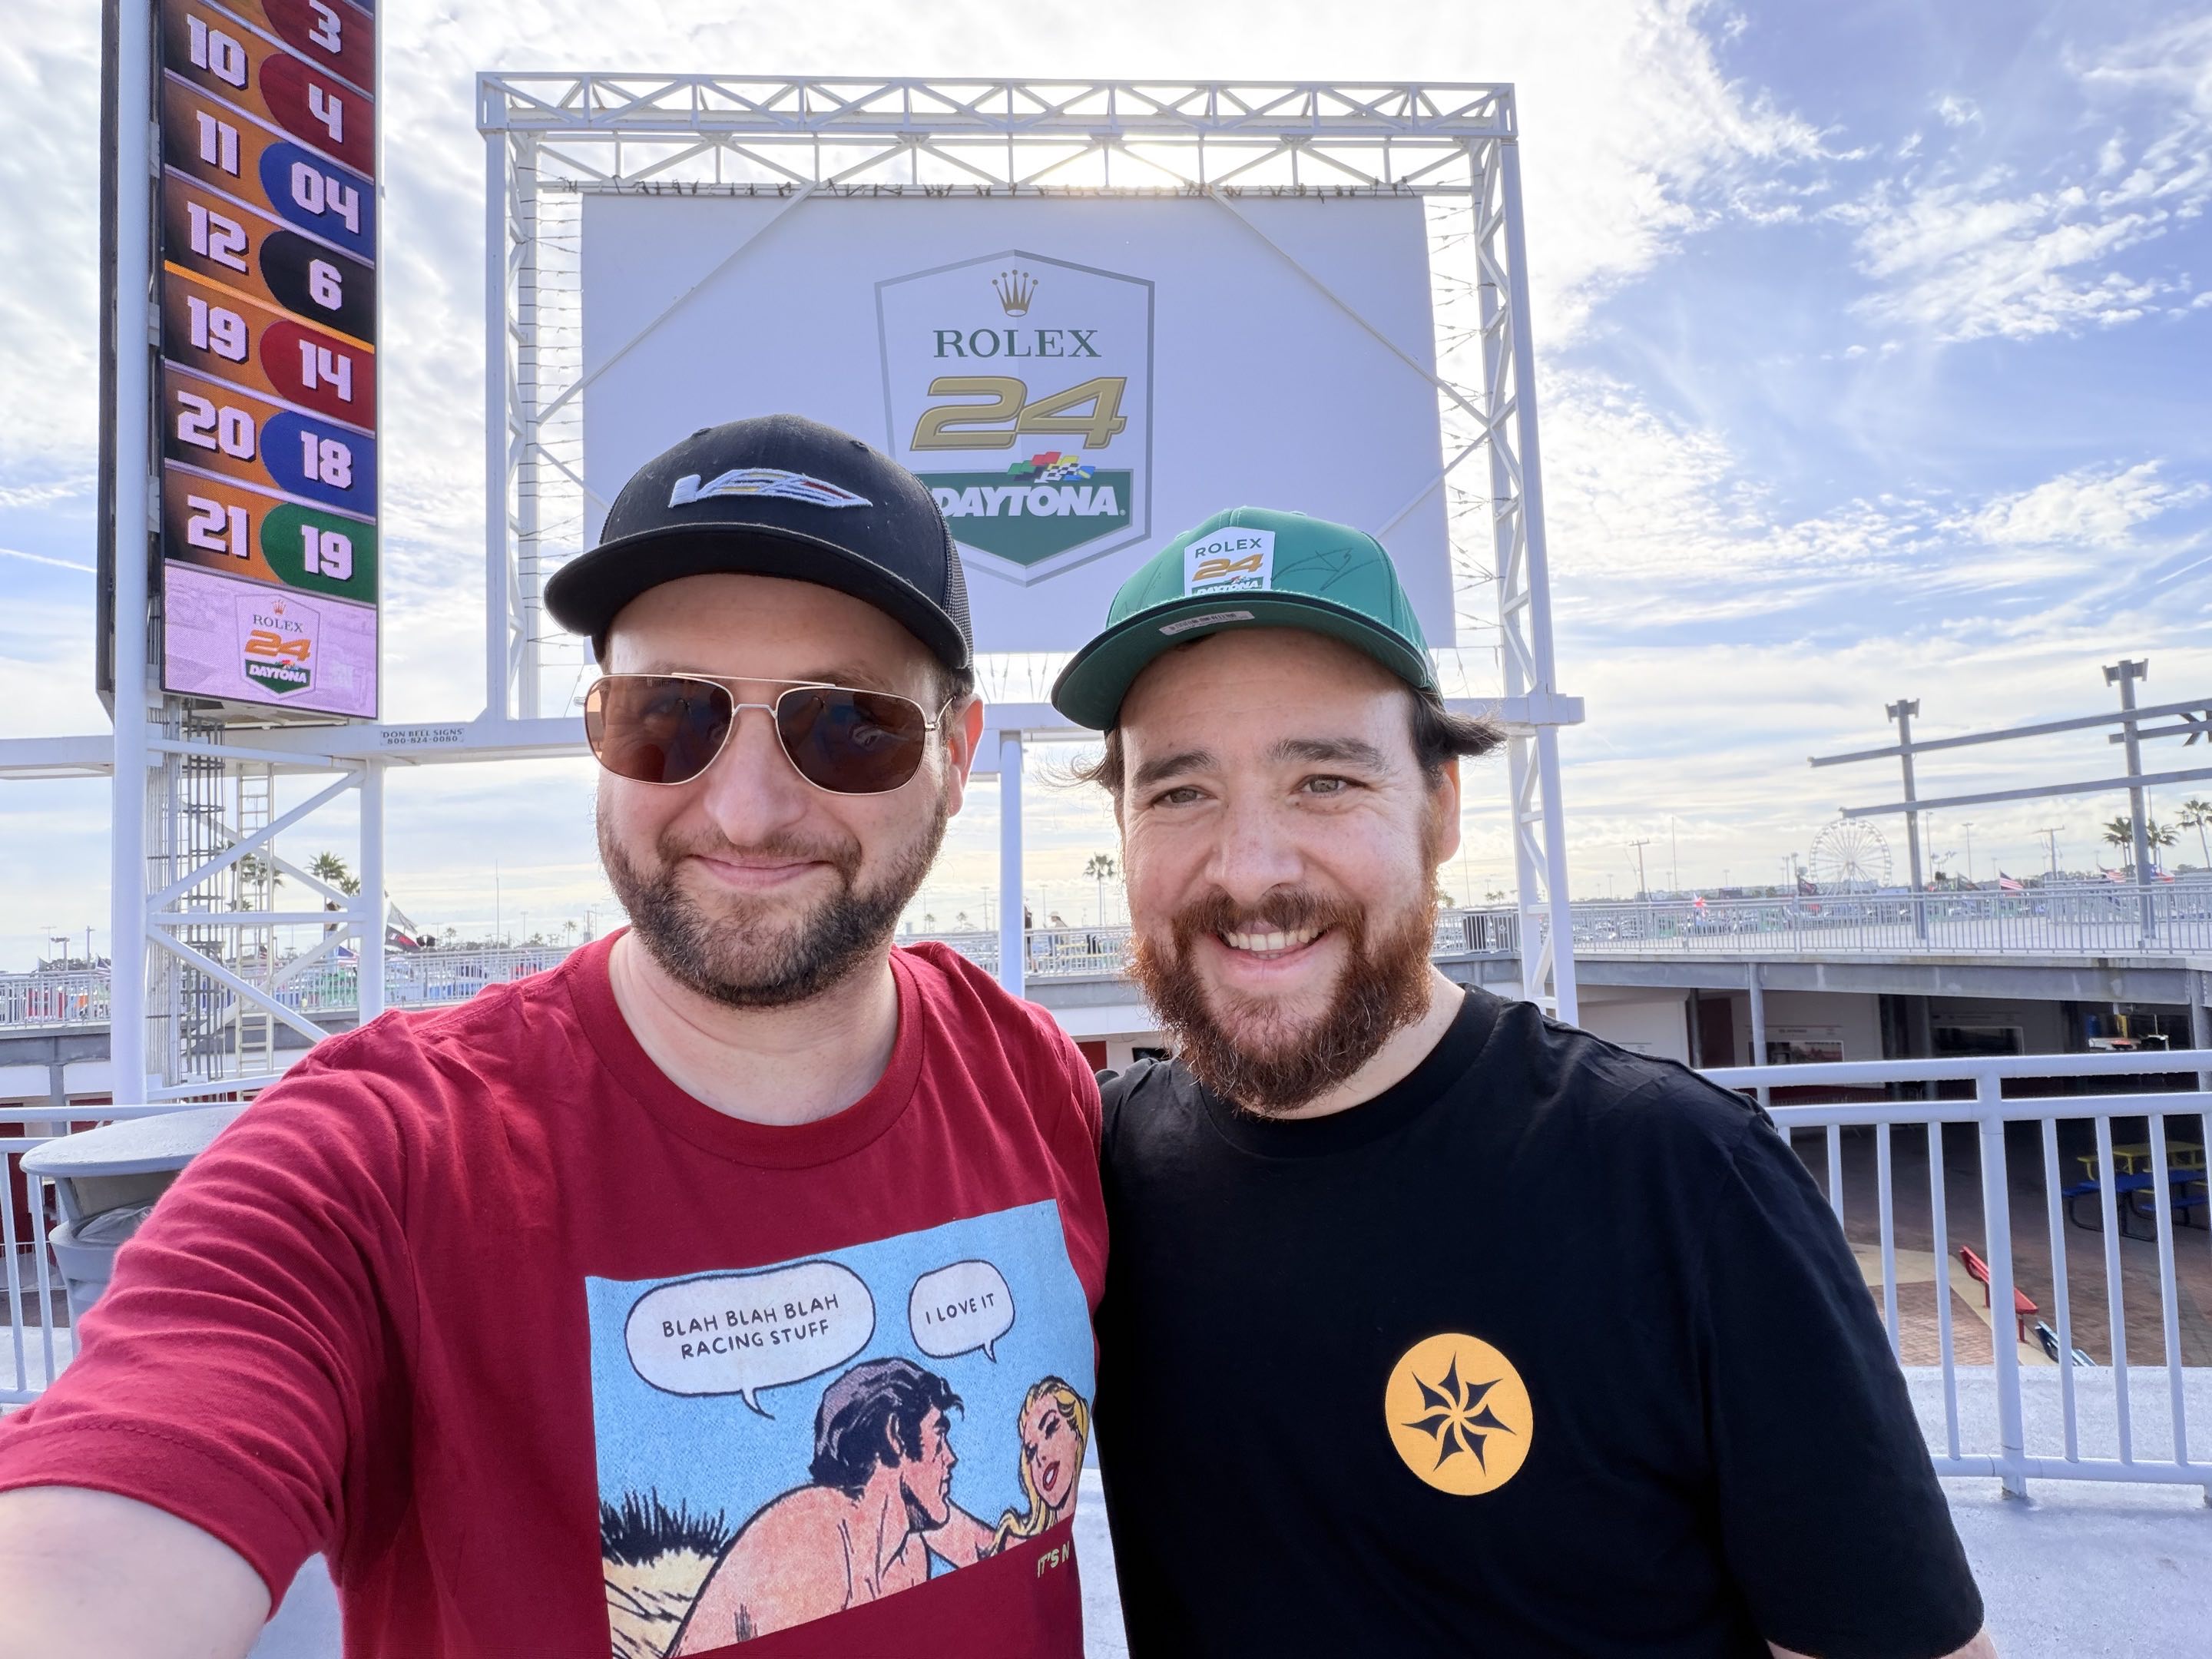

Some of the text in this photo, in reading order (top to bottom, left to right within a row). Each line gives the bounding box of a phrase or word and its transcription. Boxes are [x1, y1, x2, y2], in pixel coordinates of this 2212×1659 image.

[310, 0, 341, 54] 3
[187, 13, 343, 143] 10 4
[197, 110, 359, 233] 11 04
[187, 201, 343, 310] 12 6
[187, 295, 352, 402] 19 14
[933, 329, 1102, 358] ROLEX
[909, 376, 1128, 452] 24
[177, 389, 352, 489] 20 18
[932, 485, 1118, 518] DAYTONA
[187, 495, 353, 581] 21 19
[1195, 538, 1262, 558] ROLEX
[1192, 553, 1263, 581] 24
[1197, 580, 1260, 596] DAYTONA
[253, 614, 303, 633] ROLEX
[244, 630, 311, 661] 24
[249, 664, 307, 683] DAYTONA
[662, 1293, 839, 1337] BLAH BLAH BLAH
[926, 1293, 994, 1325] I LOVE IT
[681, 1320, 830, 1359] RACING STUFF
[1037, 1548, 1060, 1578] IT'S
